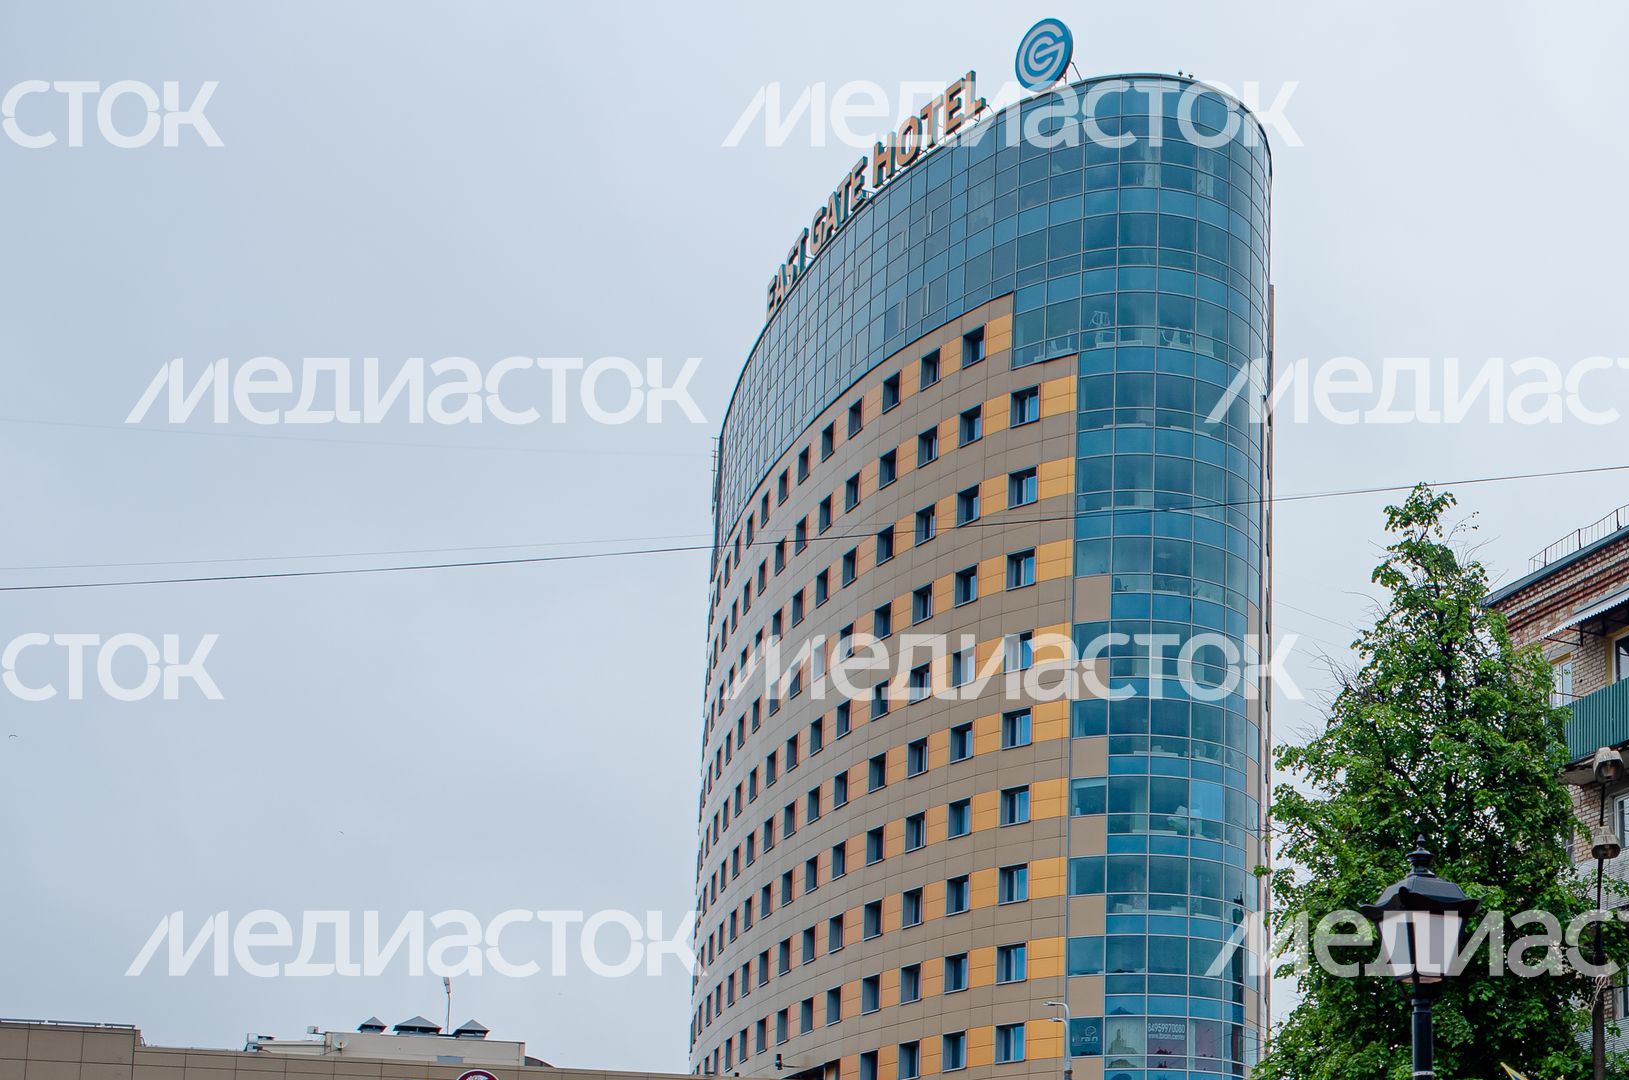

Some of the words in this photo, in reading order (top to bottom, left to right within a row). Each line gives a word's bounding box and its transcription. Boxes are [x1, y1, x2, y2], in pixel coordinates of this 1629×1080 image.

[766, 227, 809, 313] EAST
[810, 156, 869, 255] GATE
[873, 70, 987, 189] HOTEL
